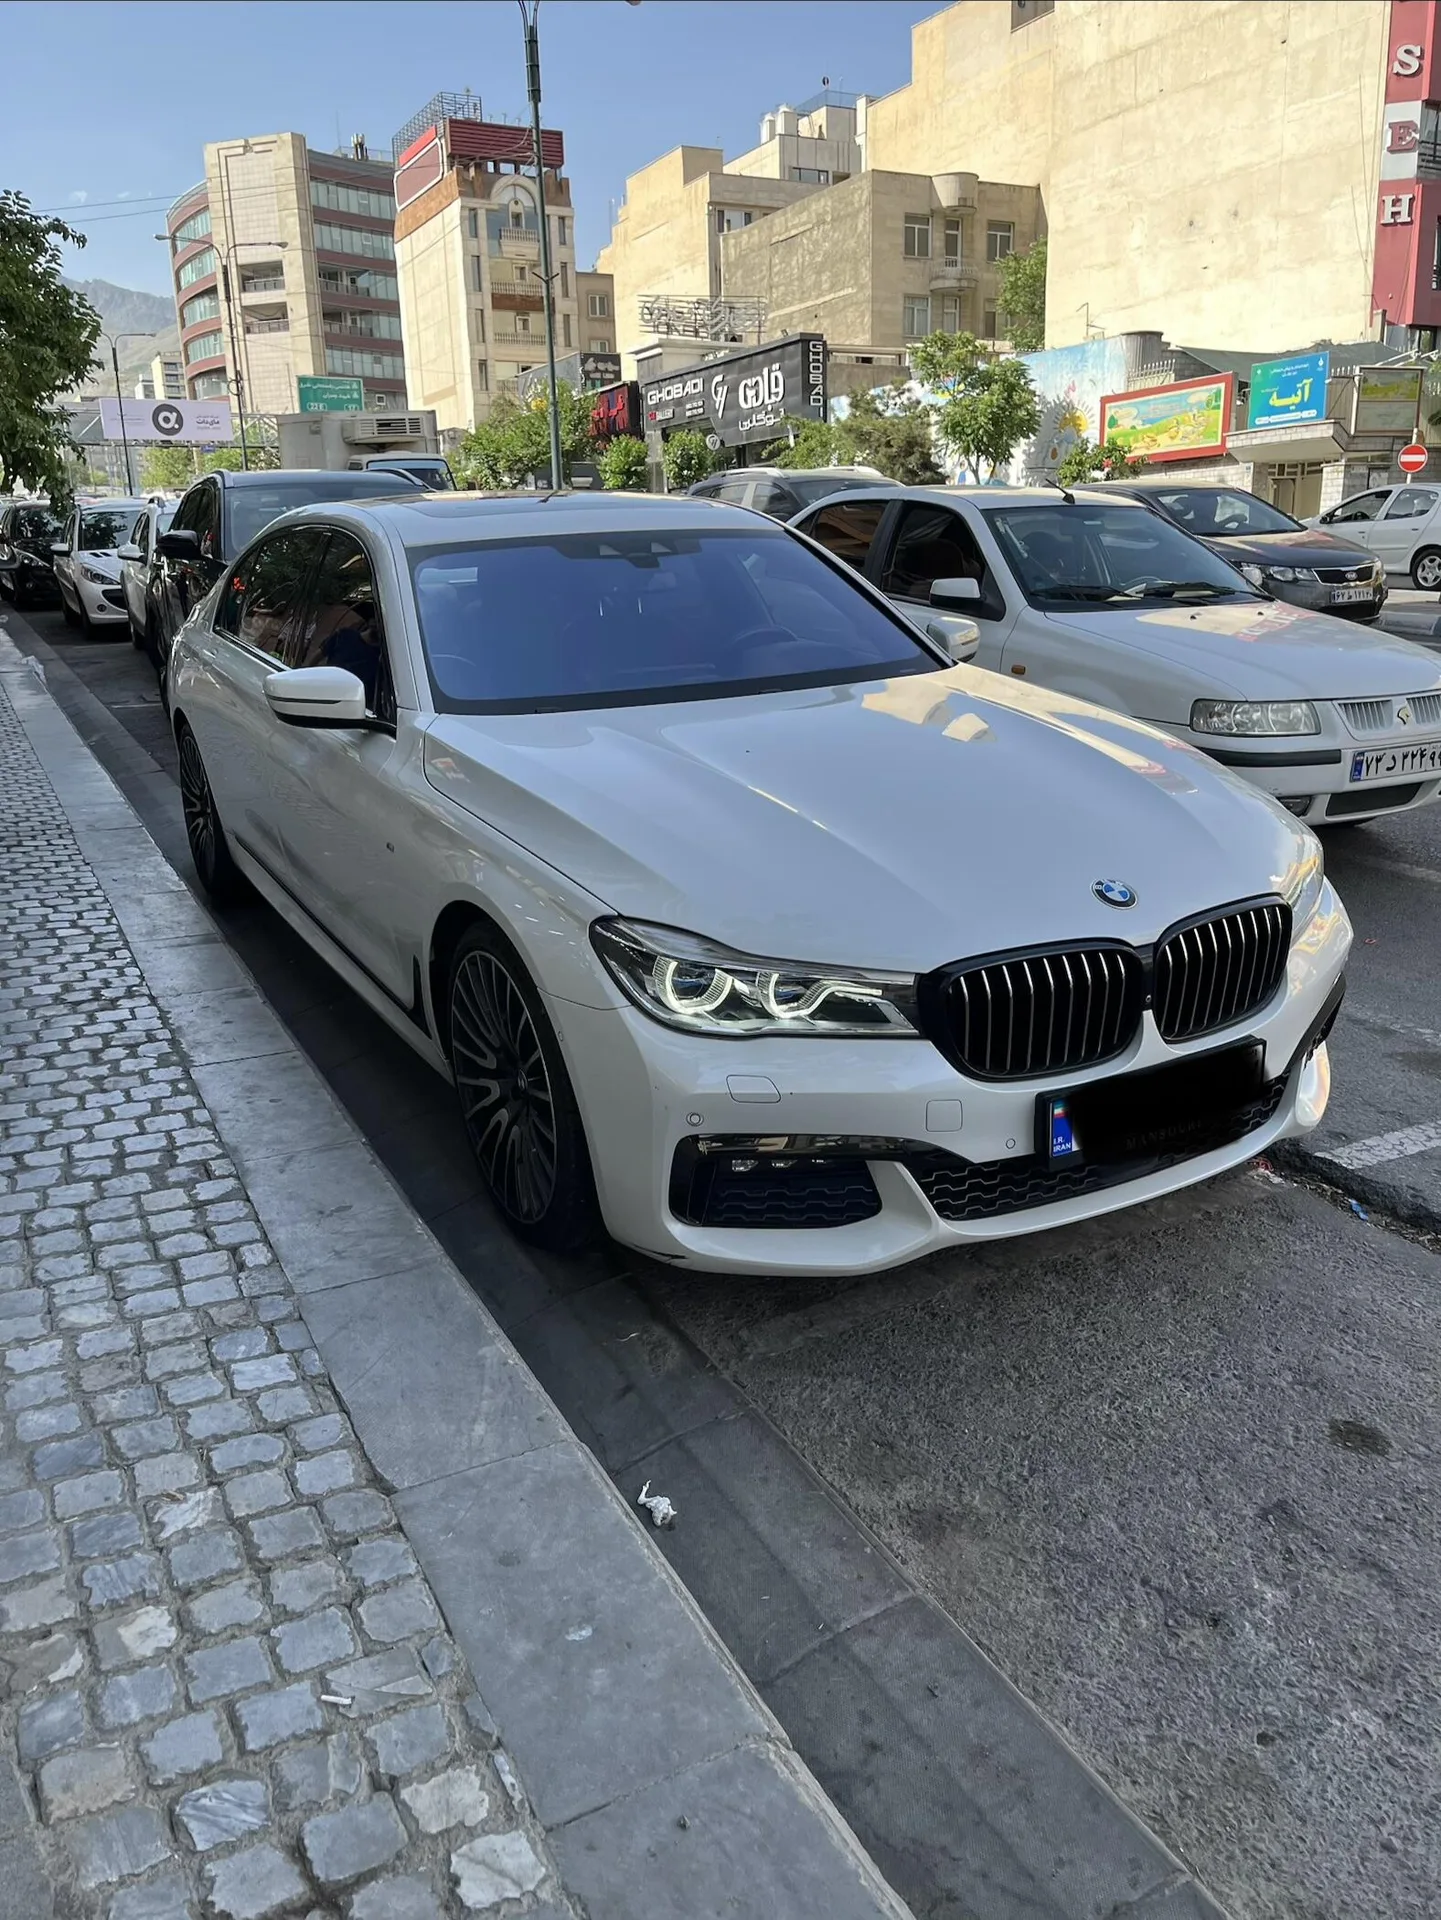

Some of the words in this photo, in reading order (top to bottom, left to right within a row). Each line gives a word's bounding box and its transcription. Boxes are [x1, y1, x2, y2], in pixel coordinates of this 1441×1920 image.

[647, 377, 704, 405] GHOBADI
[808, 340, 824, 418] GHOBADI
[1053, 1142, 1071, 1153] IRAN
